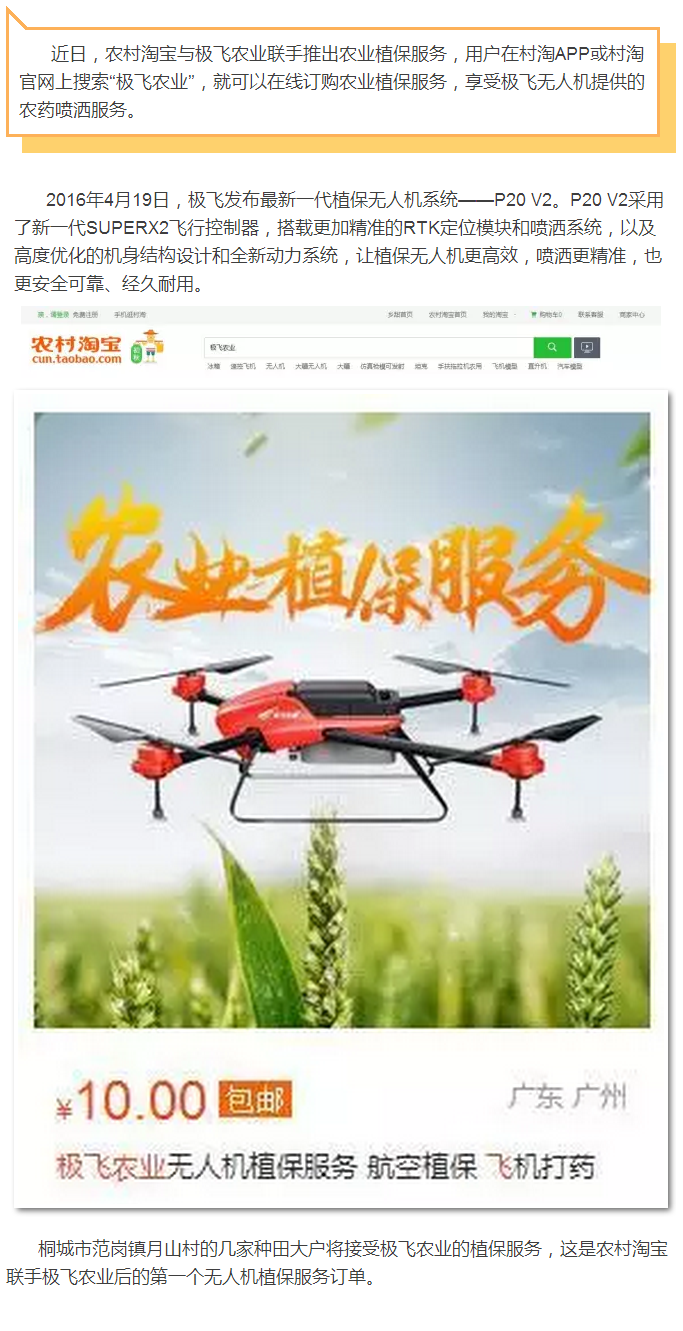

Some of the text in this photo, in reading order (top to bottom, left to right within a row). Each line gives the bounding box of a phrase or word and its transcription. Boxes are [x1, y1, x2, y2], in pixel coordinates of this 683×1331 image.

[51, 45, 644, 63] 近日，农村淘宝与极飞农业联手推出农业植保服务，用户在村淘APP或村淘
[19, 101, 133, 118] 农药喷洒服务。
[607, 190, 663, 209] V2采用
[15, 218, 656, 237] 了新一代SUPERX2飞行控制器，搭载更加精准的RTK定位模块和喷洒系统，以及
[14, 246, 662, 265] 高度优化的机身结构设计和全新动力系统，让植保无人机更高效，喷洒更精准，也
[14, 275, 200, 292] 更安全可靠、经久耐用。
[31, 336, 122, 353] 农村淘宝
[32, 354, 122, 364] cun.taobao.com
[34, 483, 650, 643] 农业植保服务
[225, 1084, 284, 1113] 包邮
[509, 1082, 627, 1109] 广东 广州
[56, 1152, 597, 1182] 极飞农业无人机植保服务 航空植保 飞机打药
[38, 1239, 668, 1258] 桐城市范岗镇月山村的几家种田大户将接受极飞农业的植保服务，这是农村淘宝
[6, 1267, 372, 1286] 联手极飞农业后的第一个无人机植保服务订单。
